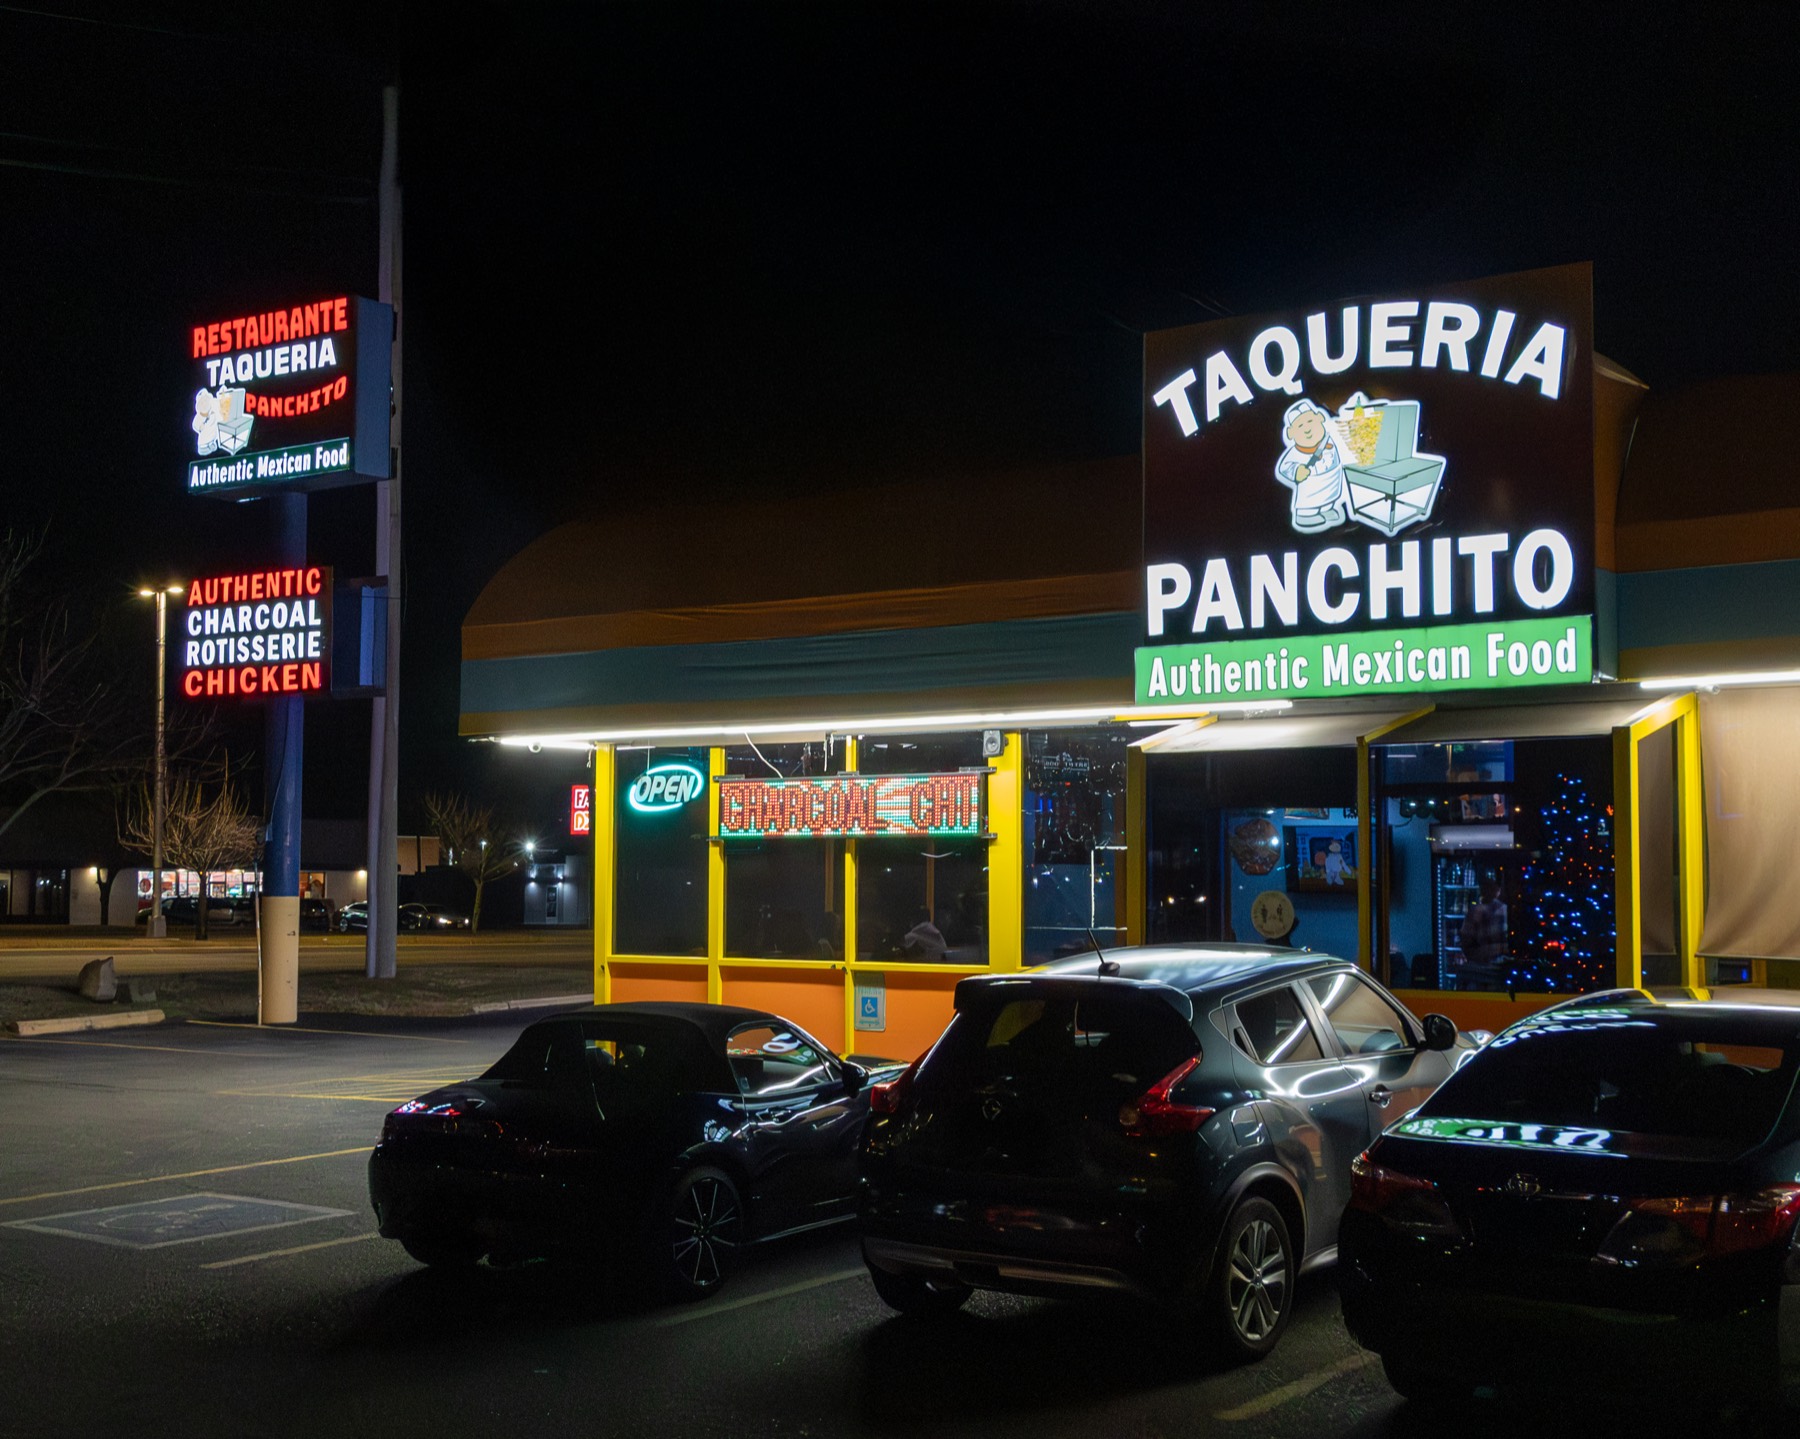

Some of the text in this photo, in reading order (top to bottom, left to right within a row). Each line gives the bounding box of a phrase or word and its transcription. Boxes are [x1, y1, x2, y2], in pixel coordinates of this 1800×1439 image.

[193, 297, 348, 359] RESTAURANTE
[206, 337, 337, 388] TAQUERIA
[1152, 300, 1566, 438] TAQUERIA
[245, 375, 348, 418] PANCHITO
[190, 442, 348, 488] Authentic Mexican Food
[188, 567, 321, 607] AUTHENTIC
[1145, 528, 1575, 636] PANCHITO
[187, 599, 322, 636] CHARCOAL
[186, 630, 321, 667] ROTISSERIE
[1147, 628, 1577, 698] Authentic Mexican Food
[184, 662, 321, 697] CHICKEN
[635, 775, 696, 803] OPEN
[722, 782, 889, 832] CHARCOAL
